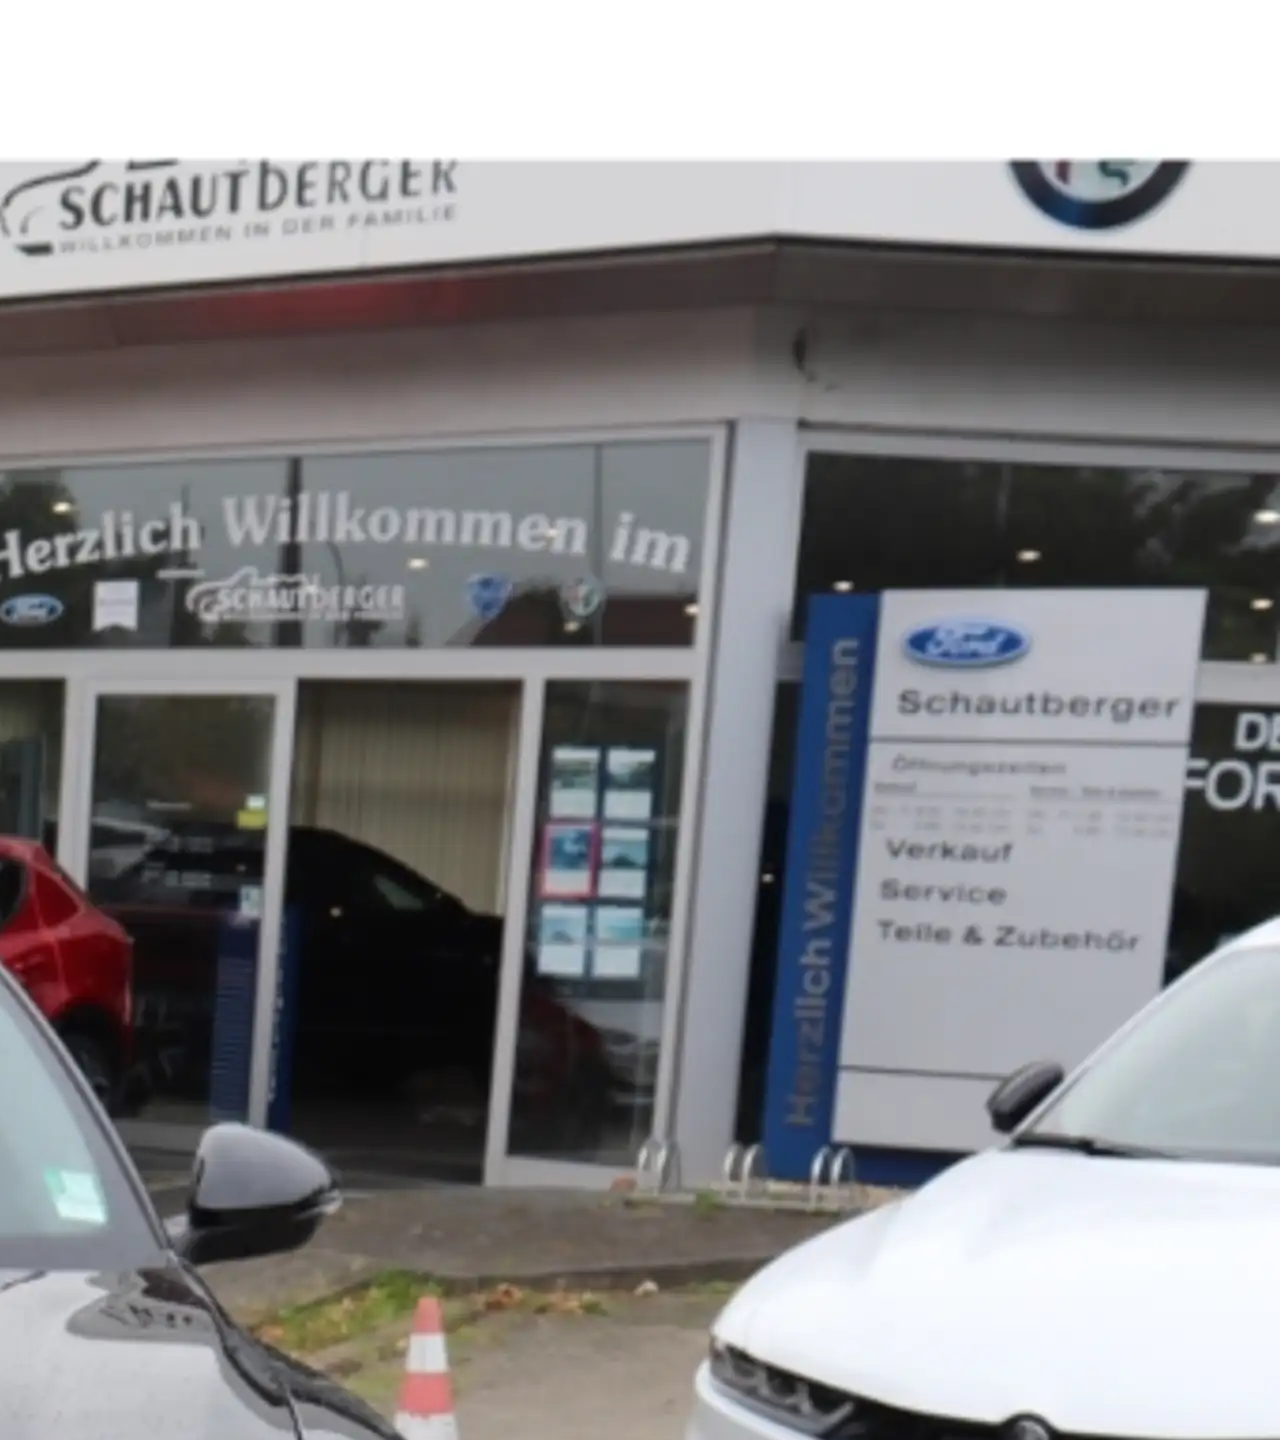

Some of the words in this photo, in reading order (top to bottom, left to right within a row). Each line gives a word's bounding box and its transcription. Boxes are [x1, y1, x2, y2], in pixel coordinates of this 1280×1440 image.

[59, 224, 231, 254] WILLKOMMEN
[244, 220, 271, 239] IN
[281, 214, 336, 236] DER
[346, 203, 457, 229] FAMILIE
[222, 491, 587, 554] Willkommen
[608, 510, 690, 573] im
[897, 688, 1180, 724] Schautberger
[803, 637, 861, 932] Willkommen
[886, 838, 1013, 863] Verkauf
[879, 877, 1007, 905] Service
[877, 918, 952, 944] Teile
[962, 924, 984, 946] &
[994, 925, 1141, 951] Zubehör
[786, 939, 833, 1127] Herzlich
